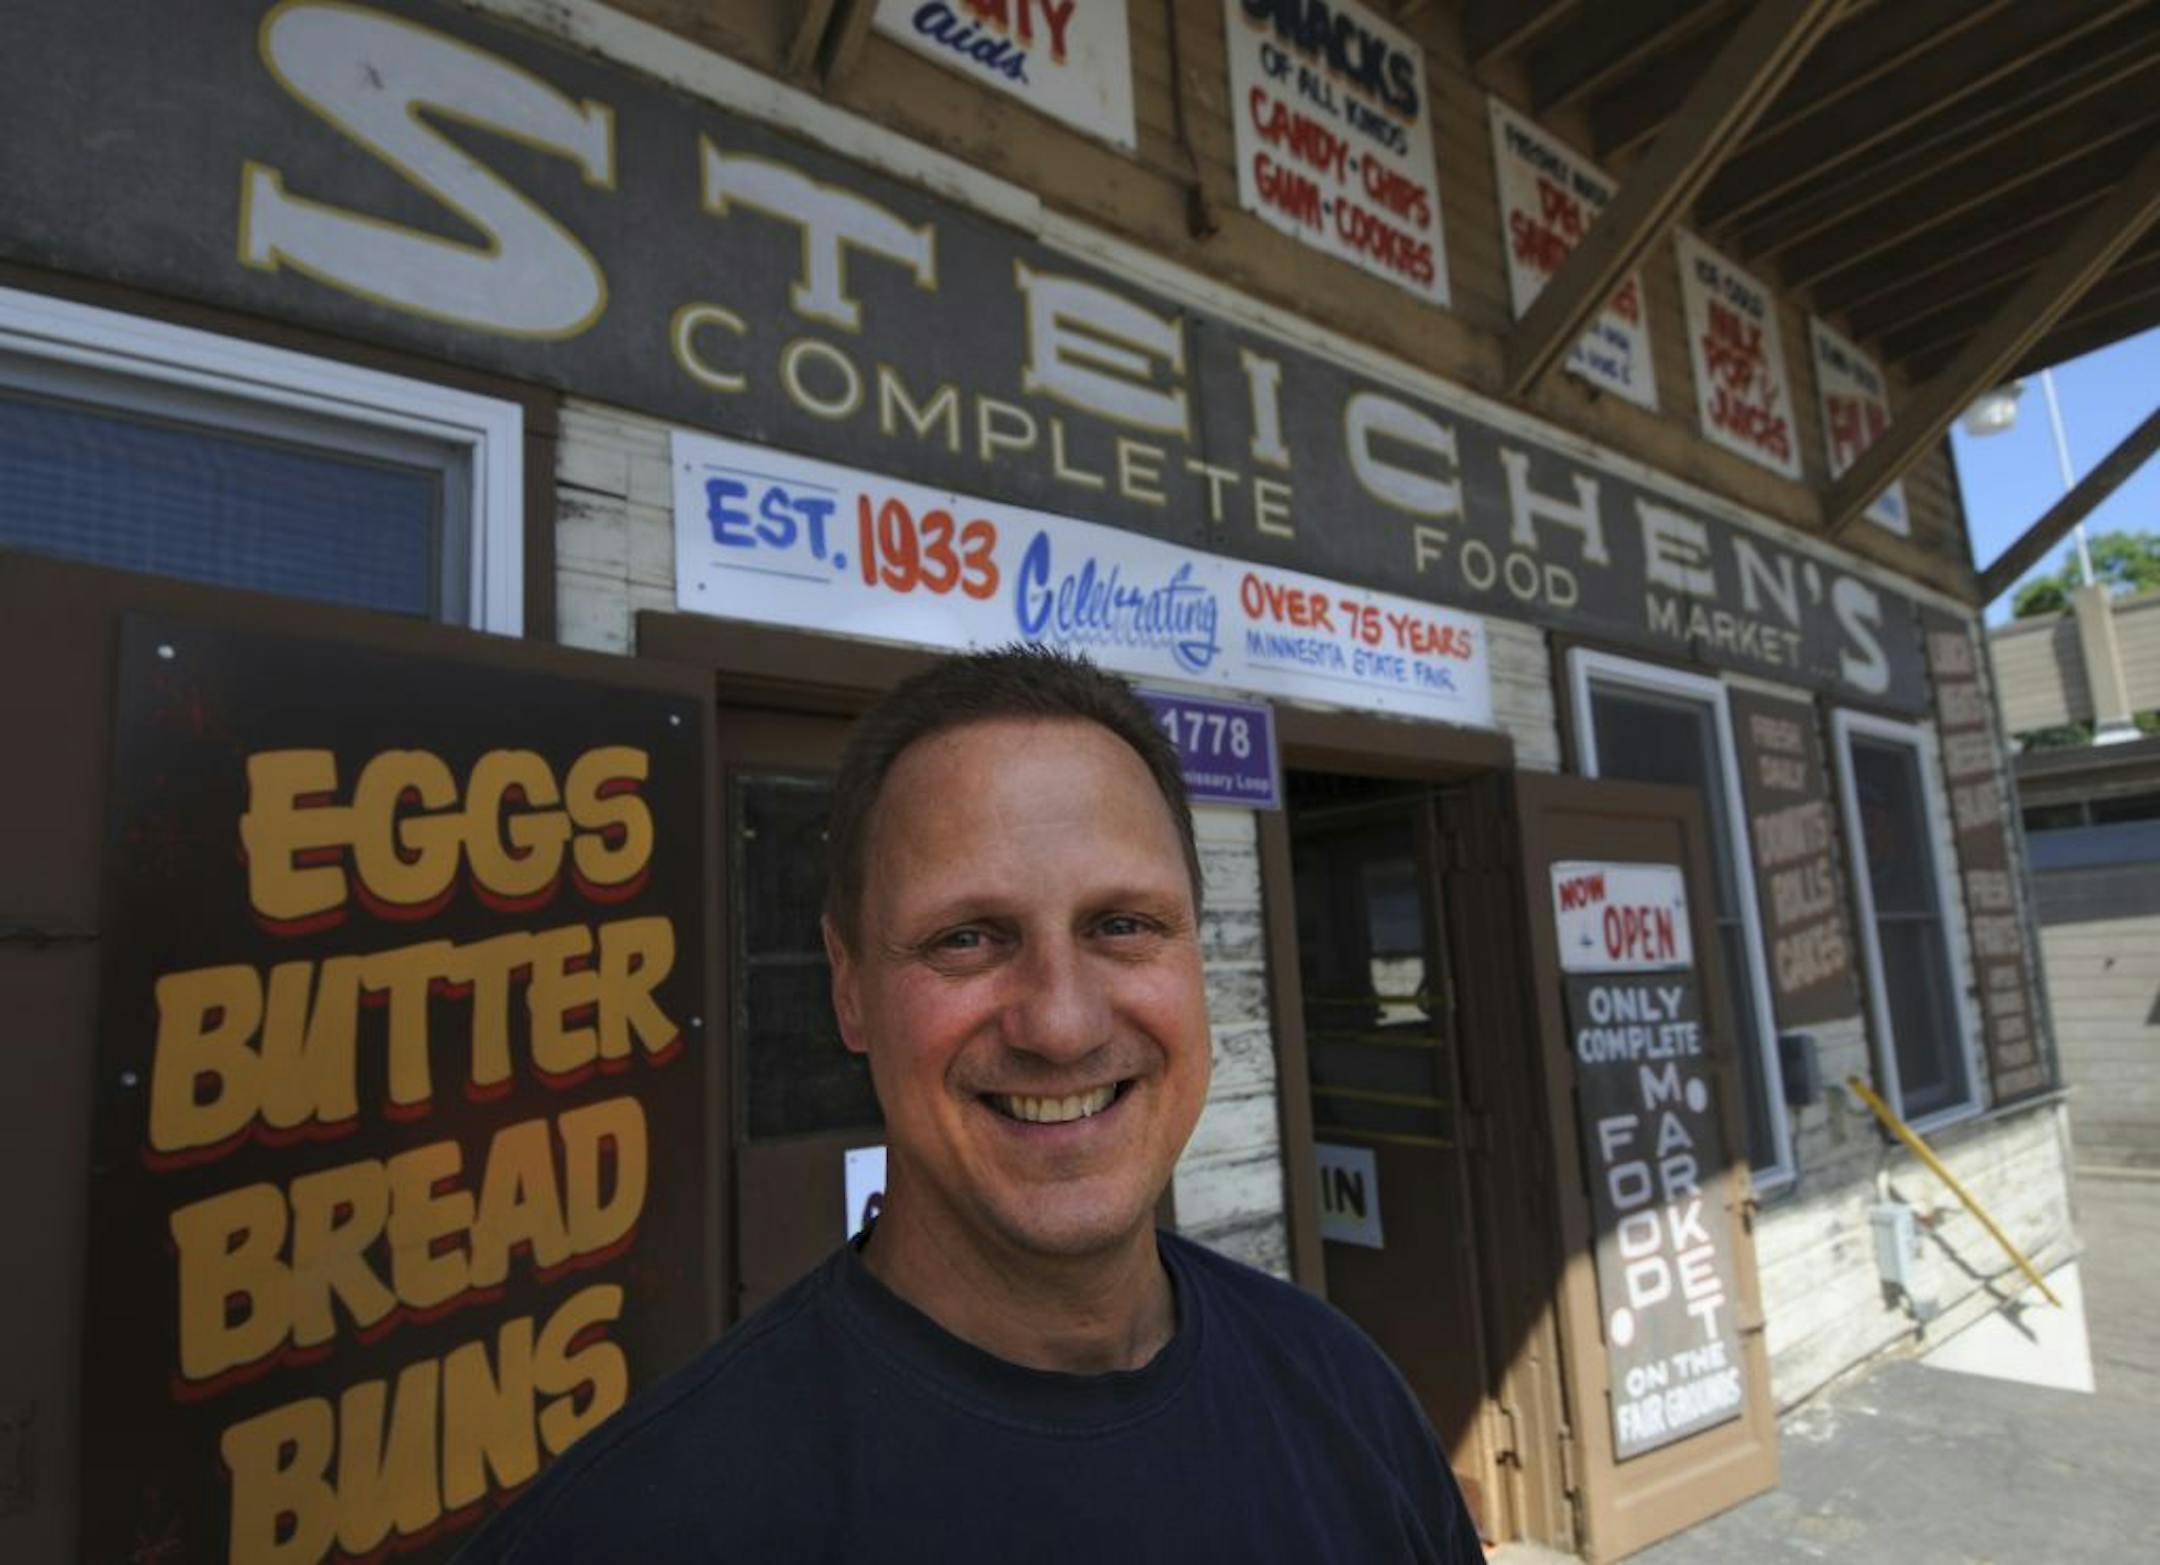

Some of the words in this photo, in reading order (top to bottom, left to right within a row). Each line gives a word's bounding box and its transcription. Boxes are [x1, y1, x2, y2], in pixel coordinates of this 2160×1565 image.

[1250, 85, 1348, 187] CANDY
[1361, 152, 1431, 229] CHIPS
[1260, 43, 1291, 83] OF
[1299, 66, 1338, 117] ALL
[1345, 97, 1408, 157] KINDS
[1254, 151, 1323, 233] GUM
[1335, 197, 1434, 289] COOKIES
[238, 0, 1890, 696] STEICHEN'S
[671, 303, 1294, 538] COMPLETE
[1413, 525, 1579, 608] FOOD
[1645, 593, 1802, 669] MARKET
[1709, 389, 1792, 464] JUICES
[706, 478, 847, 570] EST.
[857, 494, 999, 601] 1933
[1014, 530, 1221, 672] Celebrating
[1240, 573, 1335, 633] OVER
[1339, 600, 1383, 646] 75
[1386, 611, 1476, 661] YEARS
[1353, 648, 1406, 680] STATE
[1413, 663, 1457, 692] FAIR
[1161, 708, 1251, 759] 1778
[240, 745, 654, 934] EGGS
[1559, 872, 1606, 911] NOW
[1603, 905, 1676, 961] OPEN
[142, 916, 684, 1172] BUTTER
[1577, 1022, 1701, 1062] COMPLETE
[1588, 986, 1683, 1023] ONLY
[170, 1096, 648, 1402] BREAD
[1322, 1165, 1366, 1218] IN
[1598, 1114, 1672, 1311] FOOD
[1637, 1062, 1728, 1341] MARKET
[221, 1284, 628, 1565] BUNS
[1616, 1393, 1668, 1444] FAIR
[1664, 1366, 1742, 1429] GROUNDS
[1625, 1359, 1670, 1399] ON
[1671, 1341, 1727, 1378] THE
